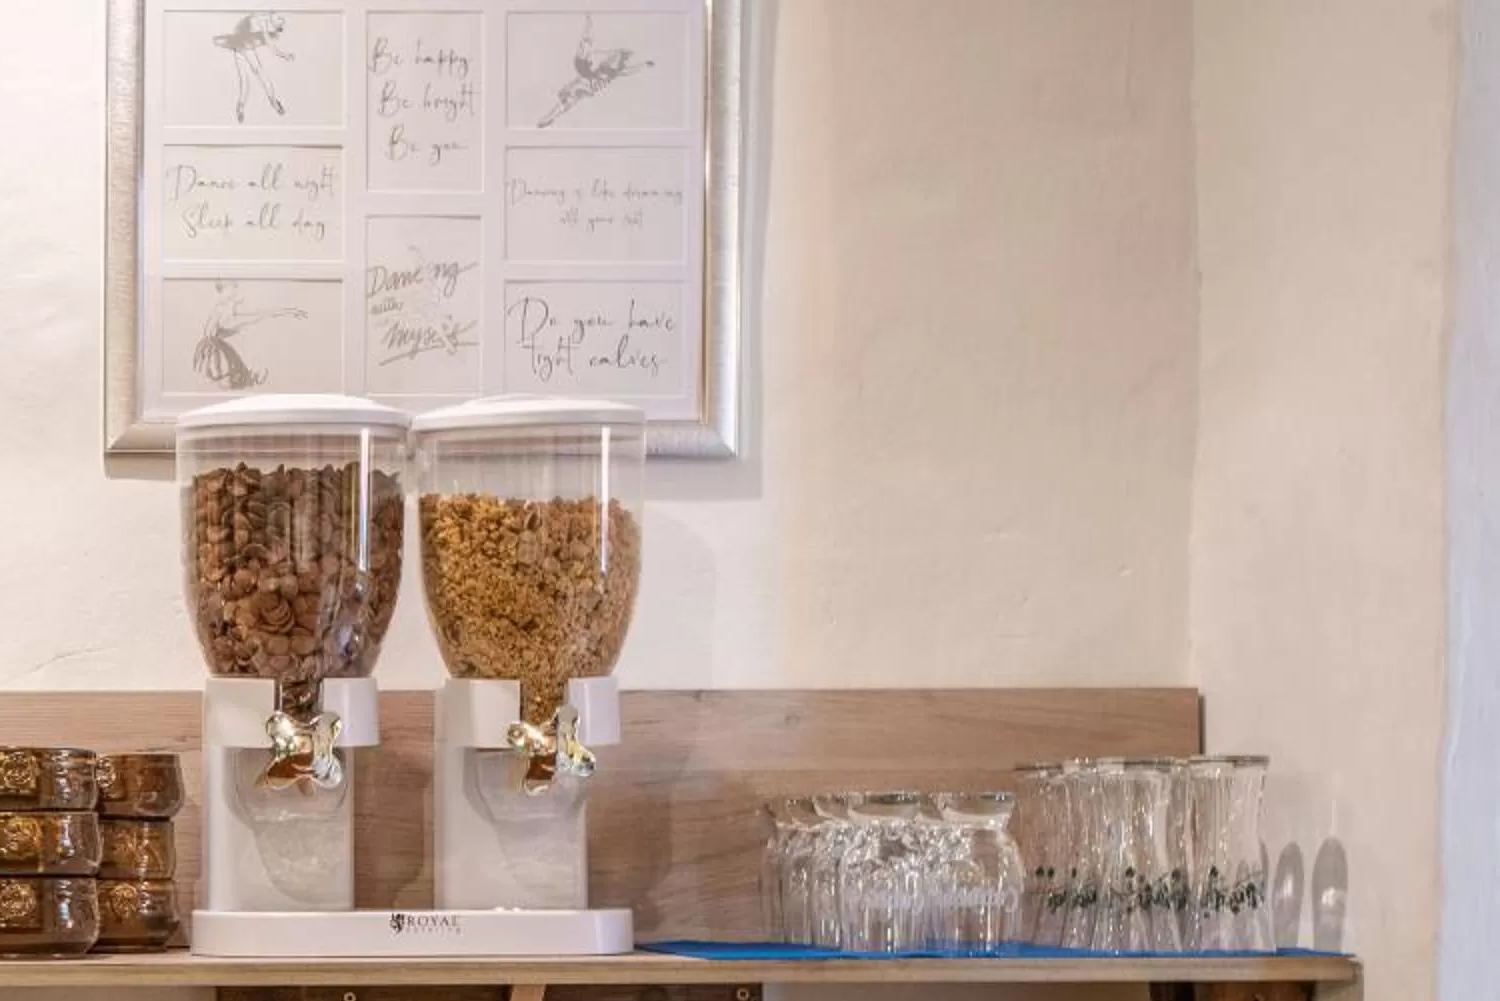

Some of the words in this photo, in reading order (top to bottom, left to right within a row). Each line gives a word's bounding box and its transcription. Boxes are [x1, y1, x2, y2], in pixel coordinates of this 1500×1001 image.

[367, 36, 404, 76] Be
[414, 36, 474, 80] happy
[377, 80, 413, 118] Be
[248, 162, 283, 191] all
[244, 201, 283, 230] all
[572, 314, 615, 345] you
[406, 915, 460, 928] ROYAL
